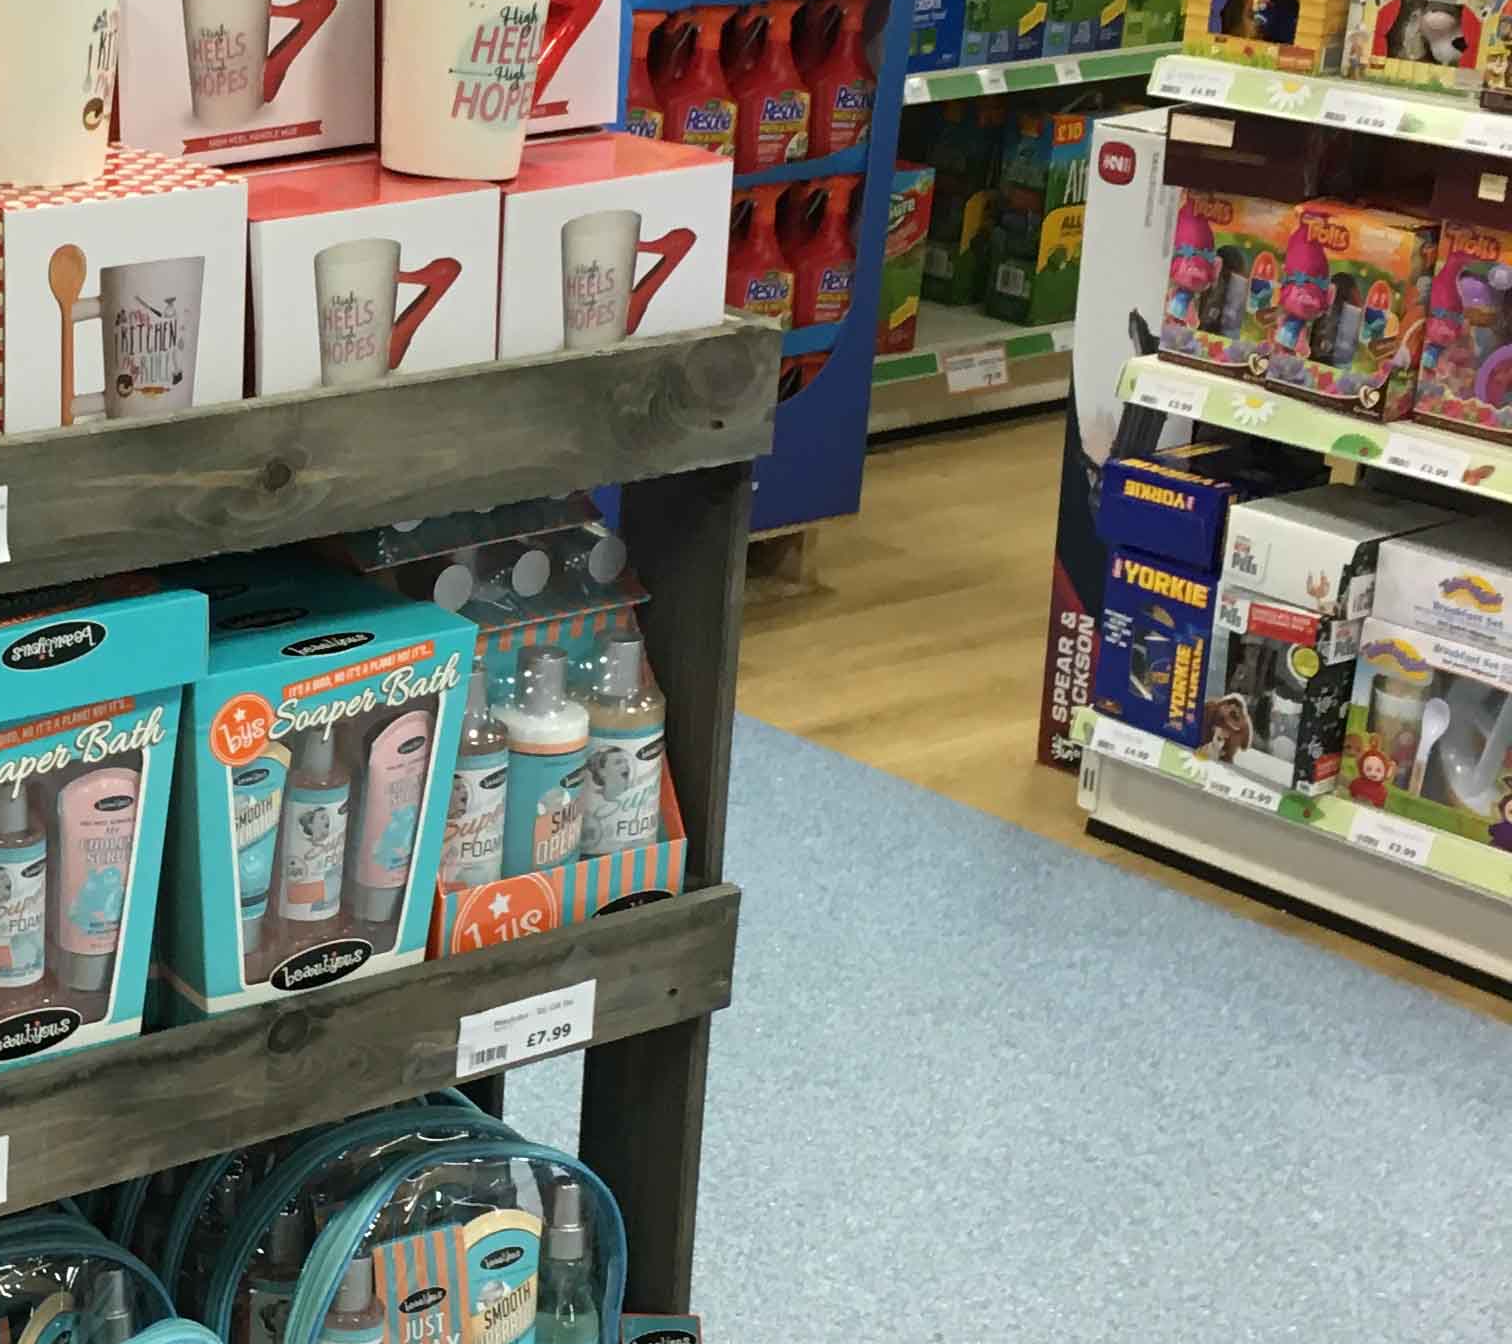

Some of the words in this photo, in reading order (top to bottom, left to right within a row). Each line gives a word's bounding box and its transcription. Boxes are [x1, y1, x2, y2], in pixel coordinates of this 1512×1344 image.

[499, 3, 539, 39] High
[192, 32, 247, 65] HEELS
[193, 66, 249, 96] HOPES
[1306, 221, 1351, 251] Trolls
[565, 269, 615, 299] HEELS
[324, 300, 375, 331] HEELS
[565, 300, 617, 330] HOPES
[118, 319, 179, 356] KITCHEN
[324, 334, 377, 364] HOPES
[1123, 559, 1210, 609] YORKIE
[1061, 610, 1078, 626] &
[1052, 634, 1077, 724] SPEAR
[1169, 644, 1192, 718] YORKIE
[268, 687, 377, 741] Soaper
[381, 651, 462, 707] Bath
[74, 706, 166, 763] Bath
[525, 1023, 573, 1048] £7.99
[483, 1280, 533, 1331] SMOOTH
[405, 1311, 445, 1343] JUST
